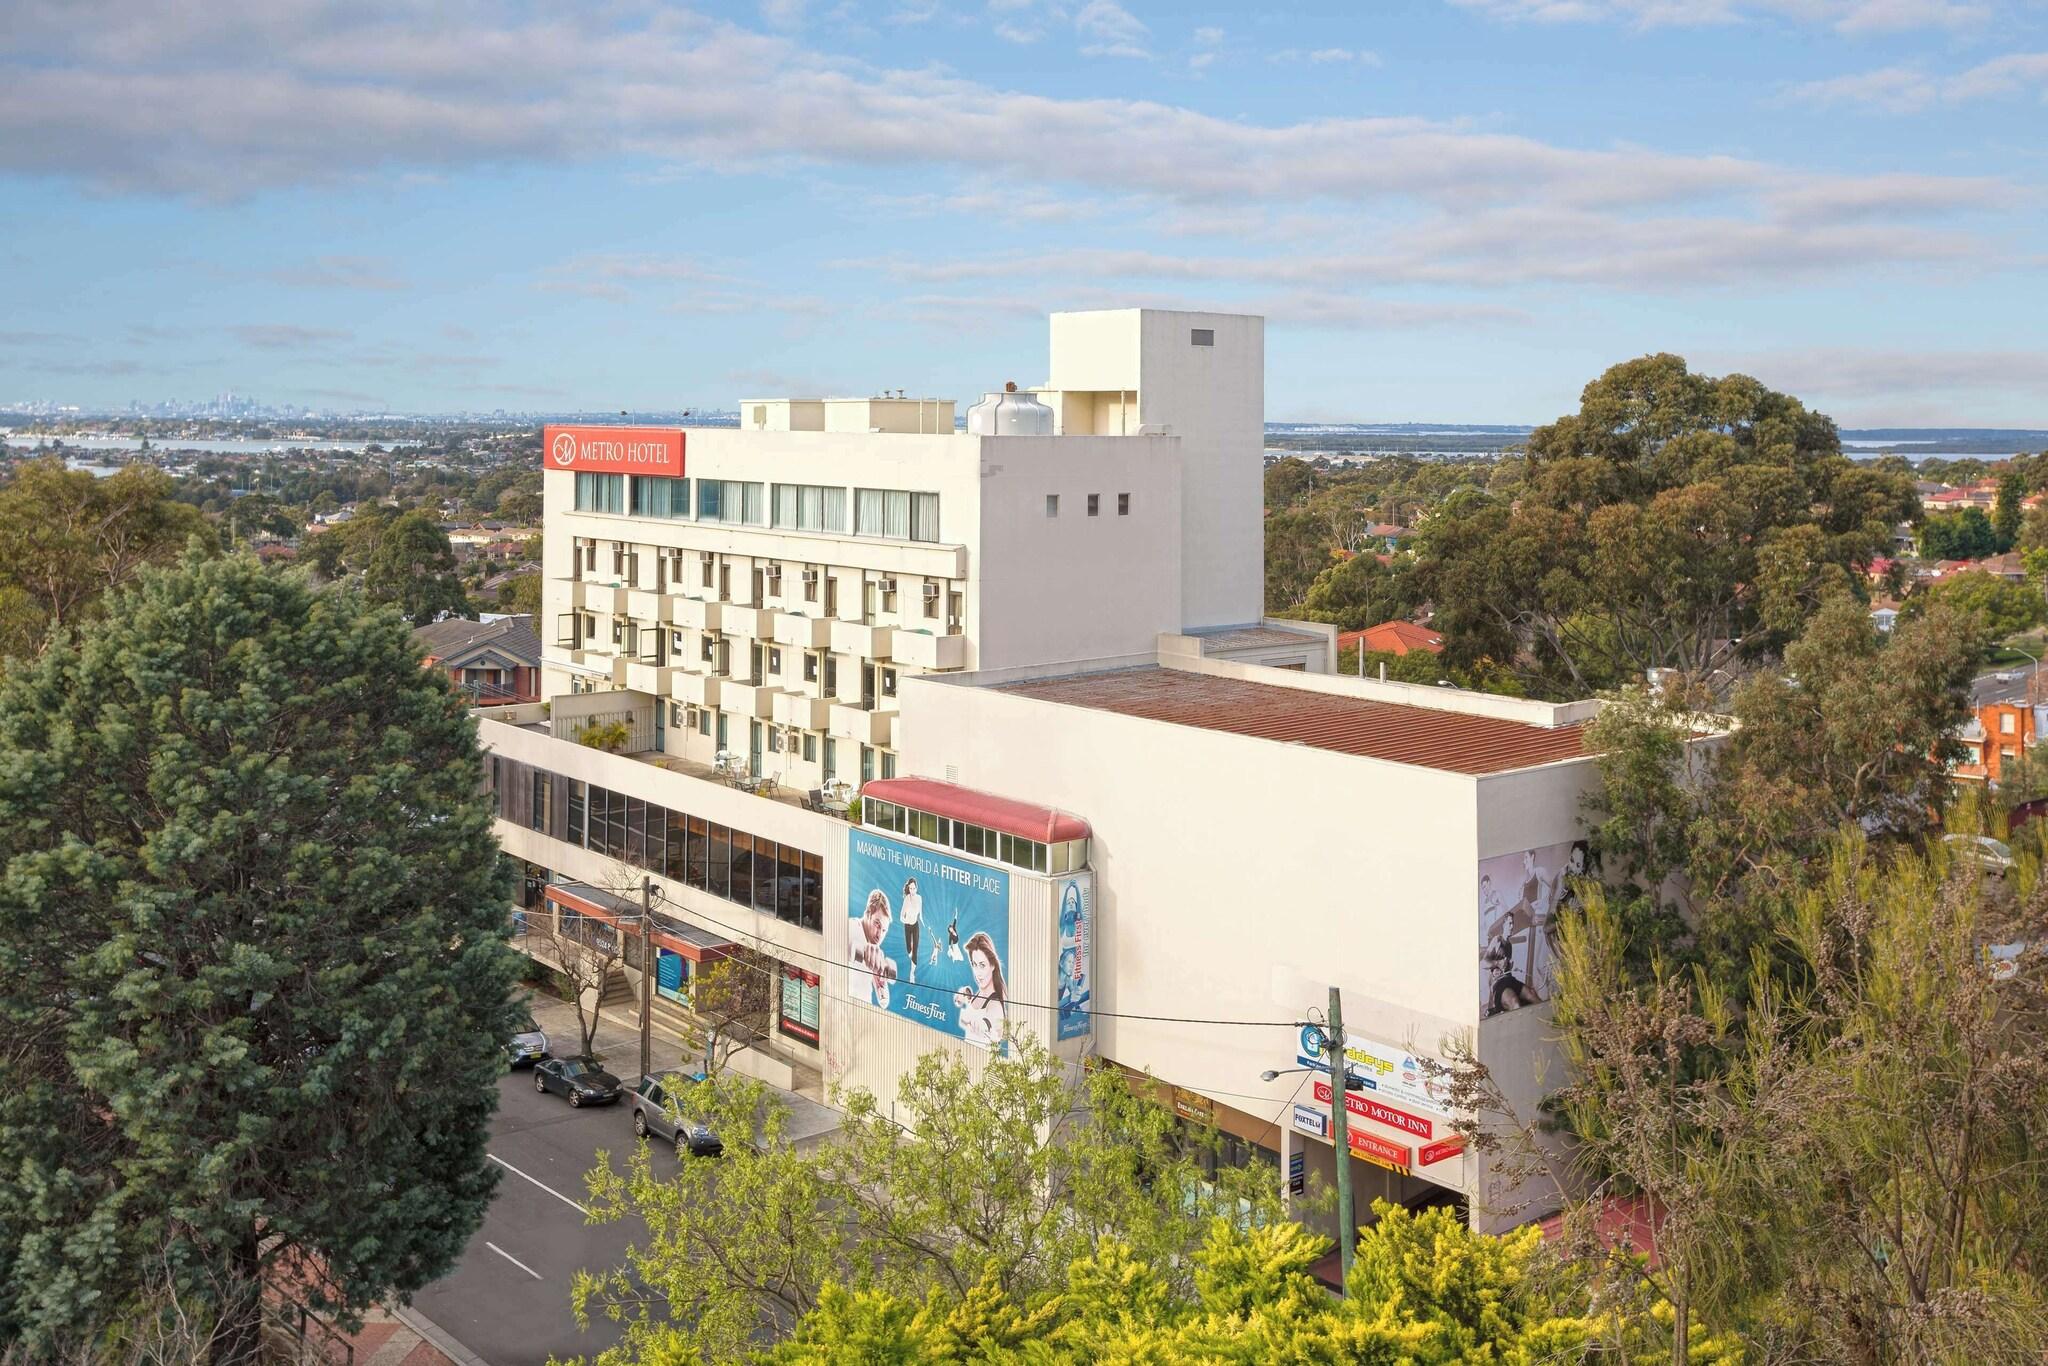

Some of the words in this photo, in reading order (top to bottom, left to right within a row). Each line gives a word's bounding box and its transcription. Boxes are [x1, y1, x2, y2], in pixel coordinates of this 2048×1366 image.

[581, 441, 624, 463] METRO
[628, 443, 670, 465] HOTEL
[856, 840, 886, 861] MAKING
[887, 849, 902, 865] THE
[903, 853, 931, 874] WORLD
[933, 863, 940, 875] A
[941, 865, 971, 887] FITTER
[973, 874, 1001, 895] PLACE
[1074, 919, 1083, 943] First
[1074, 945, 1083, 980] Fitness
[1295, 1113, 1314, 1129] FOXTEL
[1345, 1099, 1369, 1113] ETRO
[1371, 1106, 1405, 1126] MOTOR
[1407, 1119, 1428, 1134] INN
[1358, 1137, 1398, 1159] ENTRANCE
